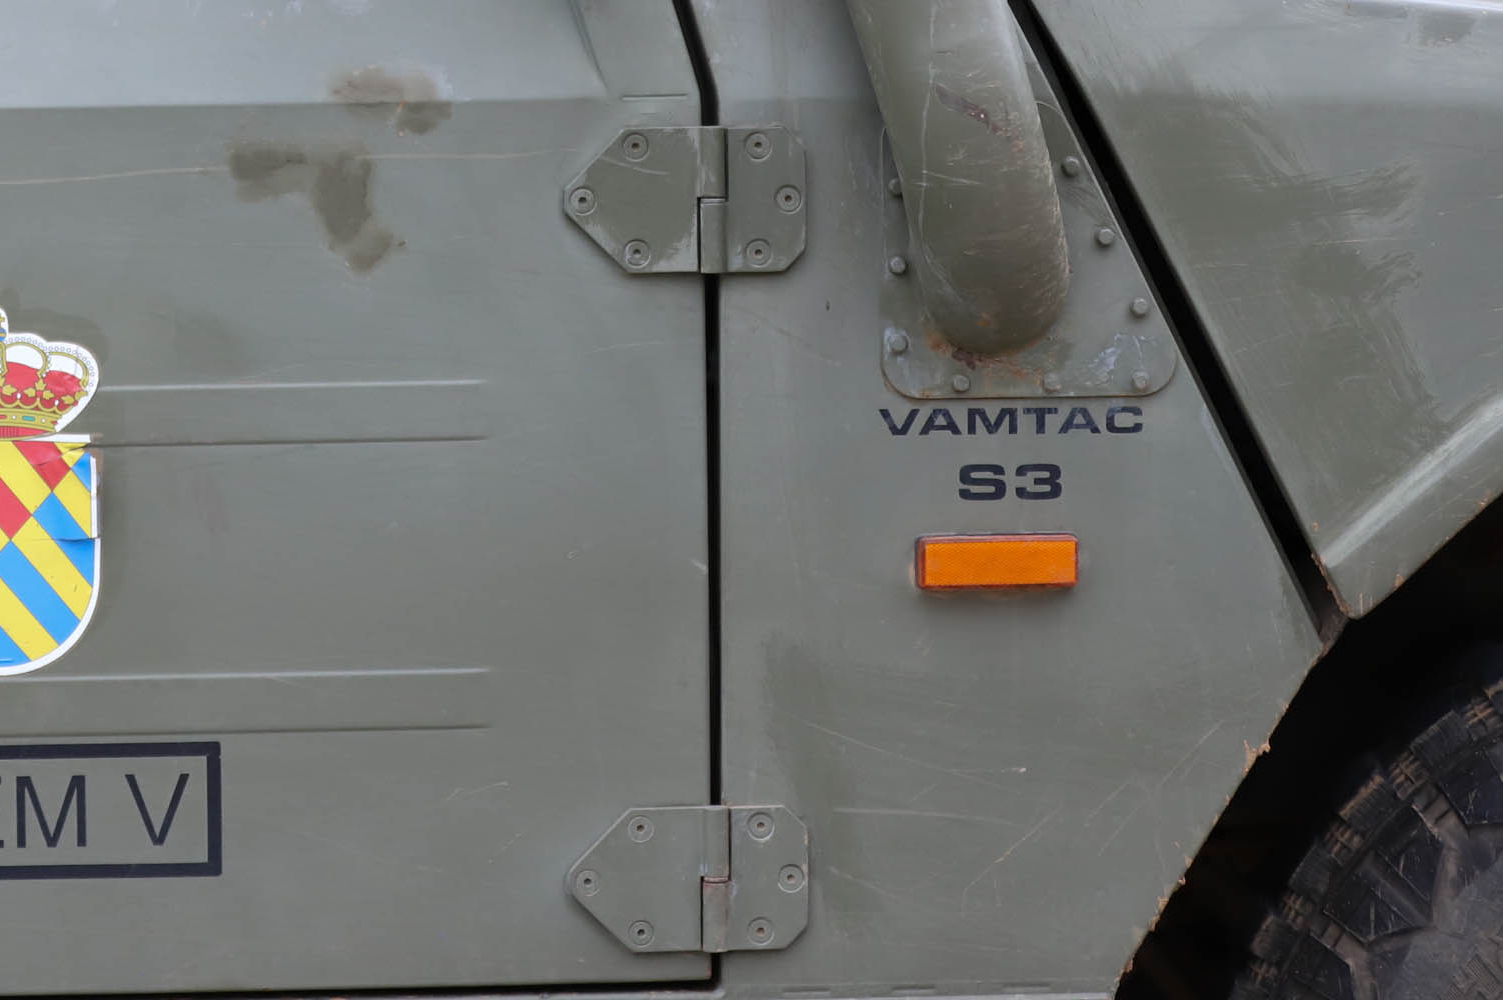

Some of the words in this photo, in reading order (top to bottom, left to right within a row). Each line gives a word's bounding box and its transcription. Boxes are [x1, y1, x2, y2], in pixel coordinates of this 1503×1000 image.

[878, 406, 1144, 436] VAMTAC
[958, 463, 1062, 500] S3
[124, 773, 190, 846] V
